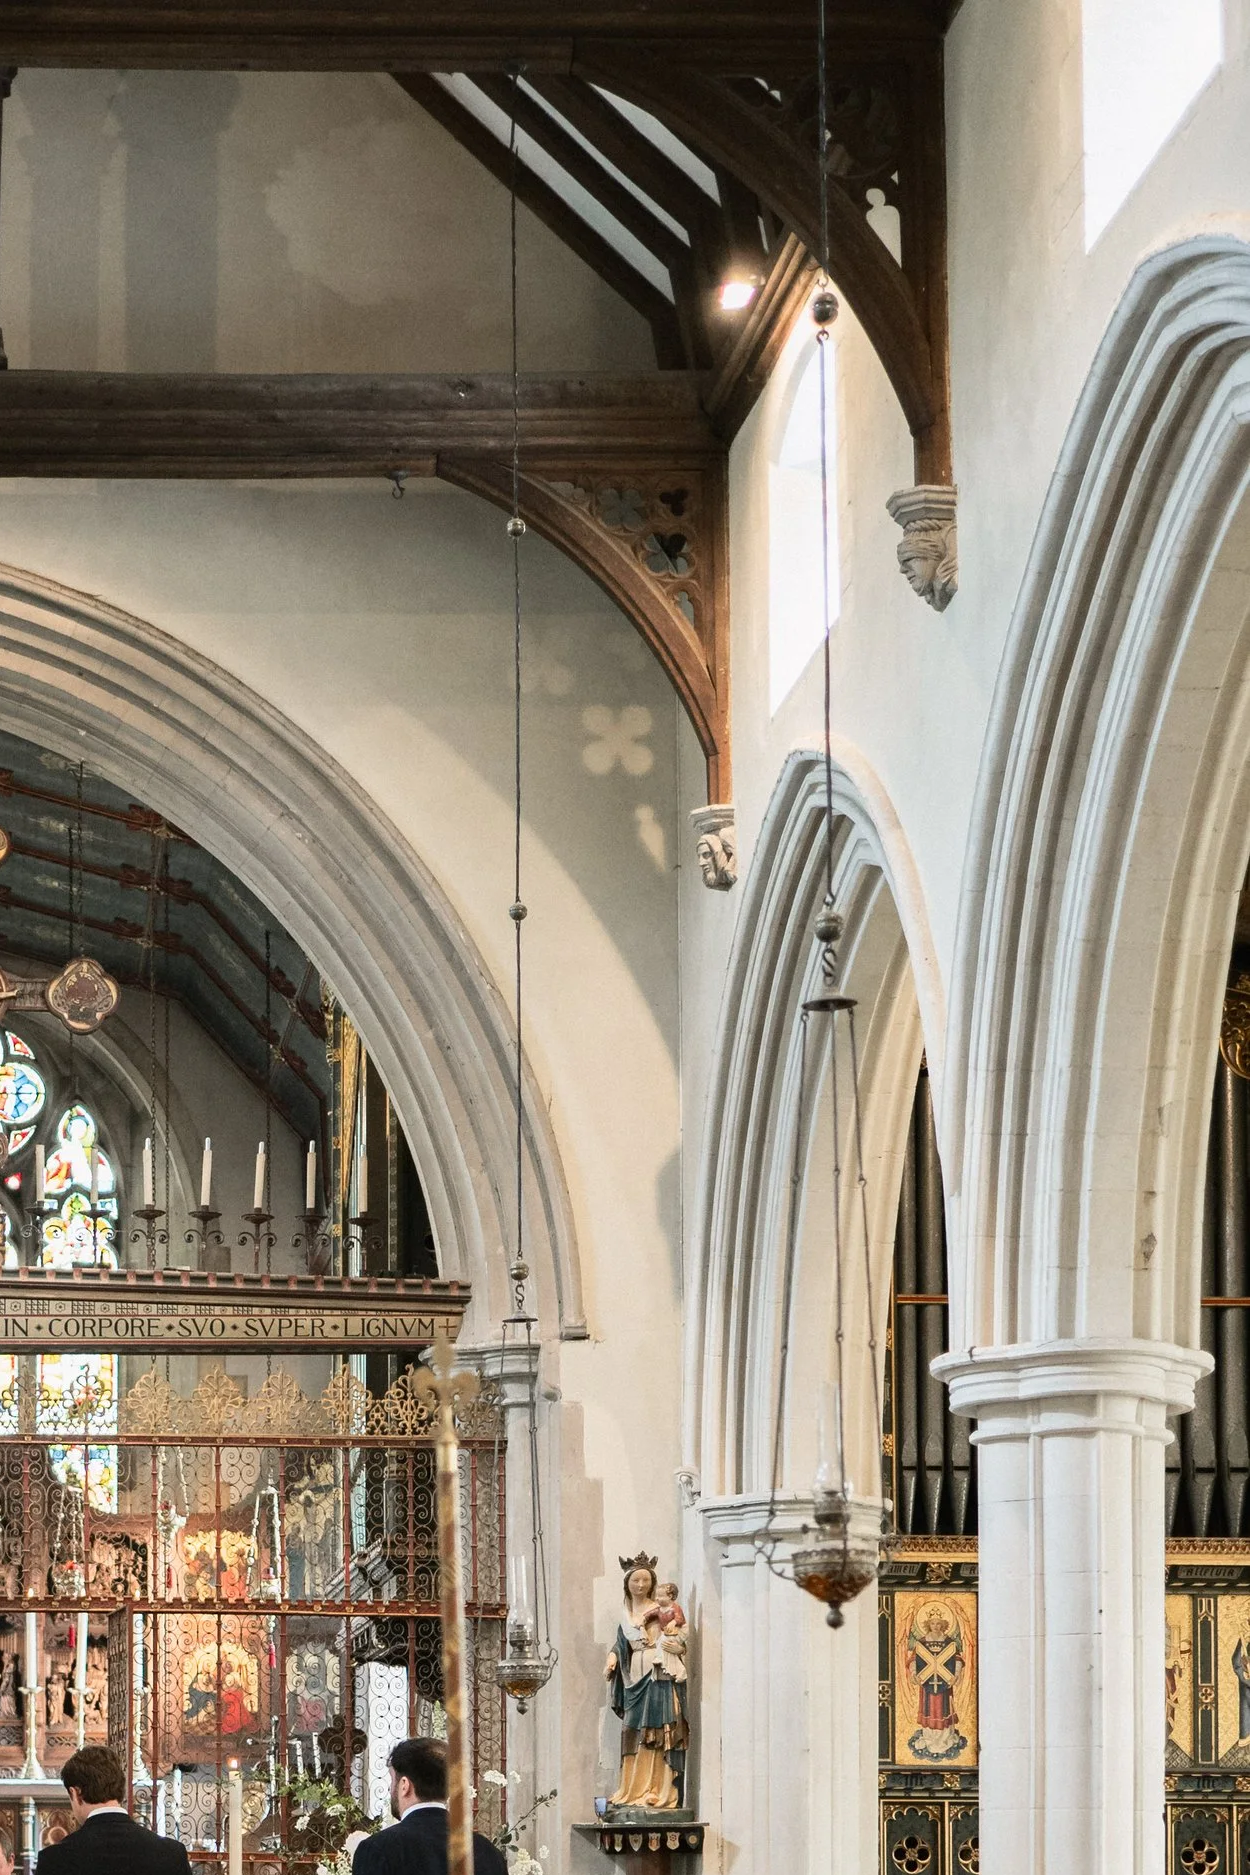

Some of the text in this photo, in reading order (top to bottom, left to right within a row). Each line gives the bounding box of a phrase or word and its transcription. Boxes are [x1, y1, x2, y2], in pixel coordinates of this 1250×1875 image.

[4, 1318, 29, 1337] IN
[48, 1318, 164, 1337] CORPORE
[177, 1318, 225, 1337] SVO
[244, 1318, 329, 1338] SVPER
[344, 1318, 434, 1337] LIGNVM
